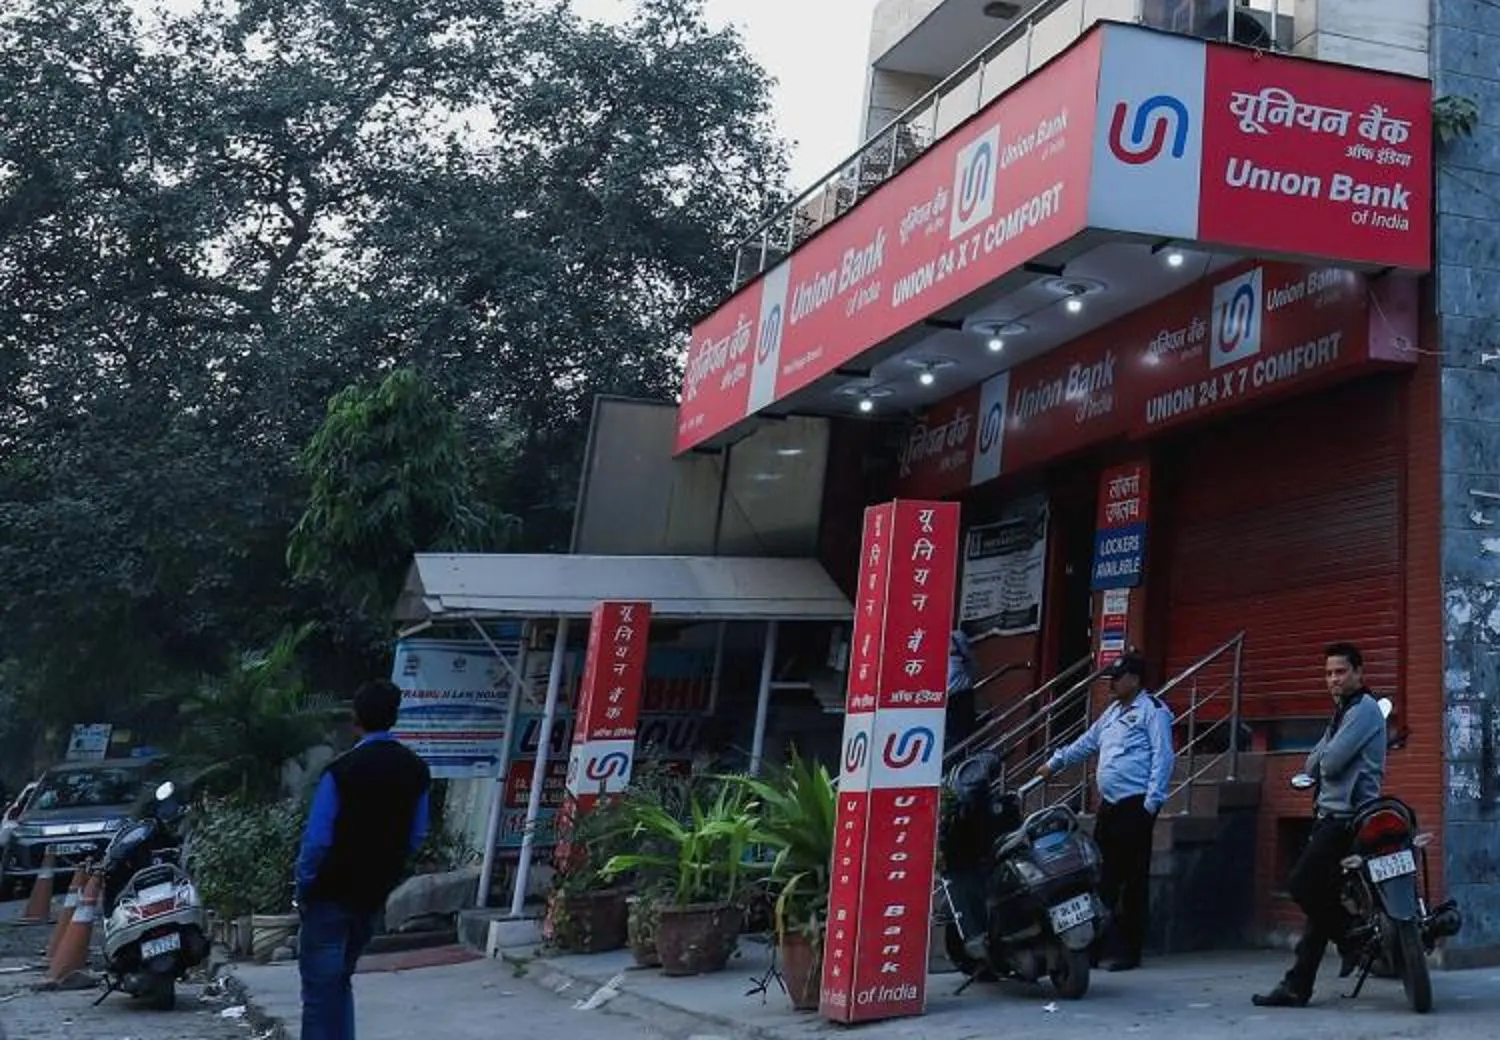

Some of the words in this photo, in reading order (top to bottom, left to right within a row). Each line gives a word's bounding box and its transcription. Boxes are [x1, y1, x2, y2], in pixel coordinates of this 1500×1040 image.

[1229, 87, 1352, 136] यूनियन
[1358, 104, 1412, 145] बैंक
[1225, 157, 1321, 198] Union
[1329, 173, 1412, 211] Bank
[892, 260, 936, 307] UNION
[957, 239, 969, 270] X
[971, 234, 981, 261] 7
[983, 181, 1064, 253] COMFORT
[1371, 211, 1410, 231] India
[790, 268, 837, 325] Union
[838, 225, 886, 294] Bank
[1267, 280, 1305, 311] Union
[1013, 376, 1062, 419] Union
[1064, 349, 1117, 401] Bank
[1146, 383, 1196, 424] UNION
[1198, 378, 1218, 405] 24
[1221, 372, 1233, 399] X
[1238, 366, 1248, 393] 7
[1252, 330, 1342, 387] COMFORT
[1096, 557, 1141, 579] AVAILABLE
[1101, 534, 1140, 556] LOCKERS
[841, 800, 857, 884] Union
[887, 795, 916, 881] Union
[832, 910, 847, 977] Bank
[880, 904, 906, 974] Bank
[857, 984, 878, 1006] of
[878, 983, 918, 1003] India
